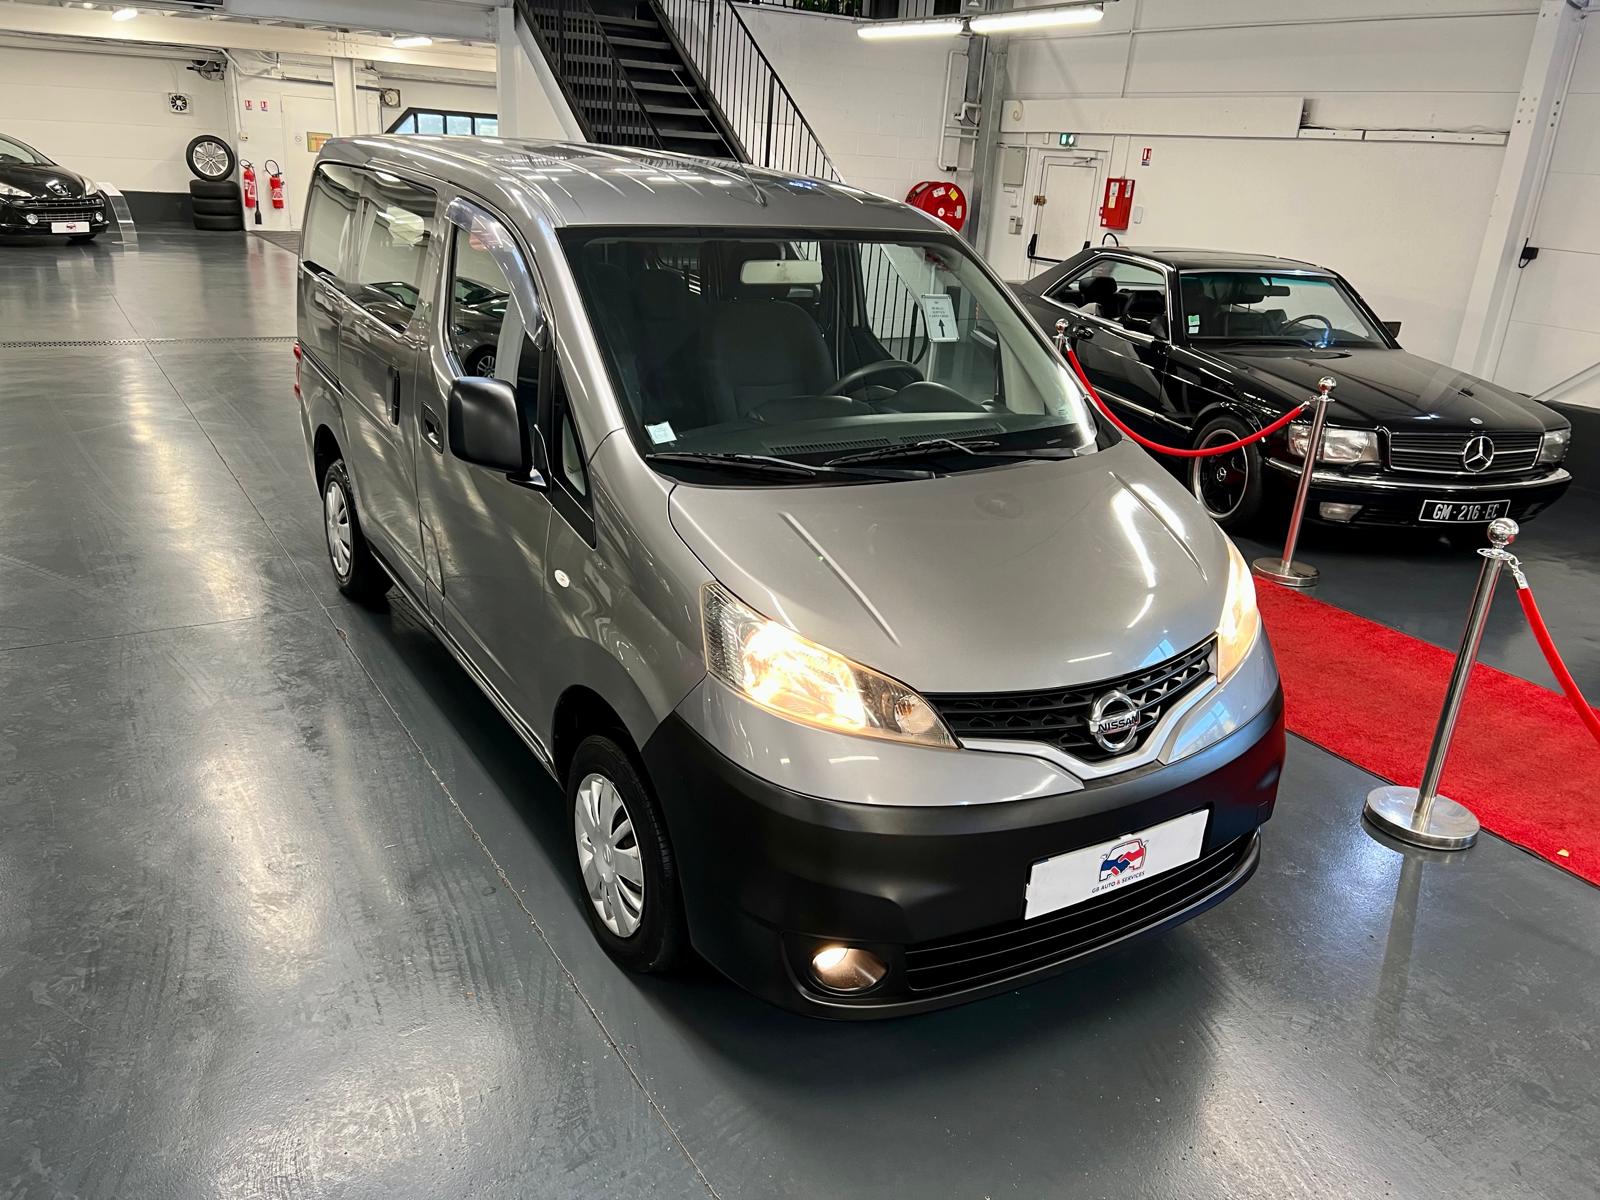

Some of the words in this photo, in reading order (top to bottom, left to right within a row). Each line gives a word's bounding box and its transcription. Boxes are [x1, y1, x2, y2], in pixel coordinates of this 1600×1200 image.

[1098, 711, 1139, 733] NISSAN
[1101, 881, 1116, 890] AUTO
[1122, 871, 1145, 883] SERVICES
